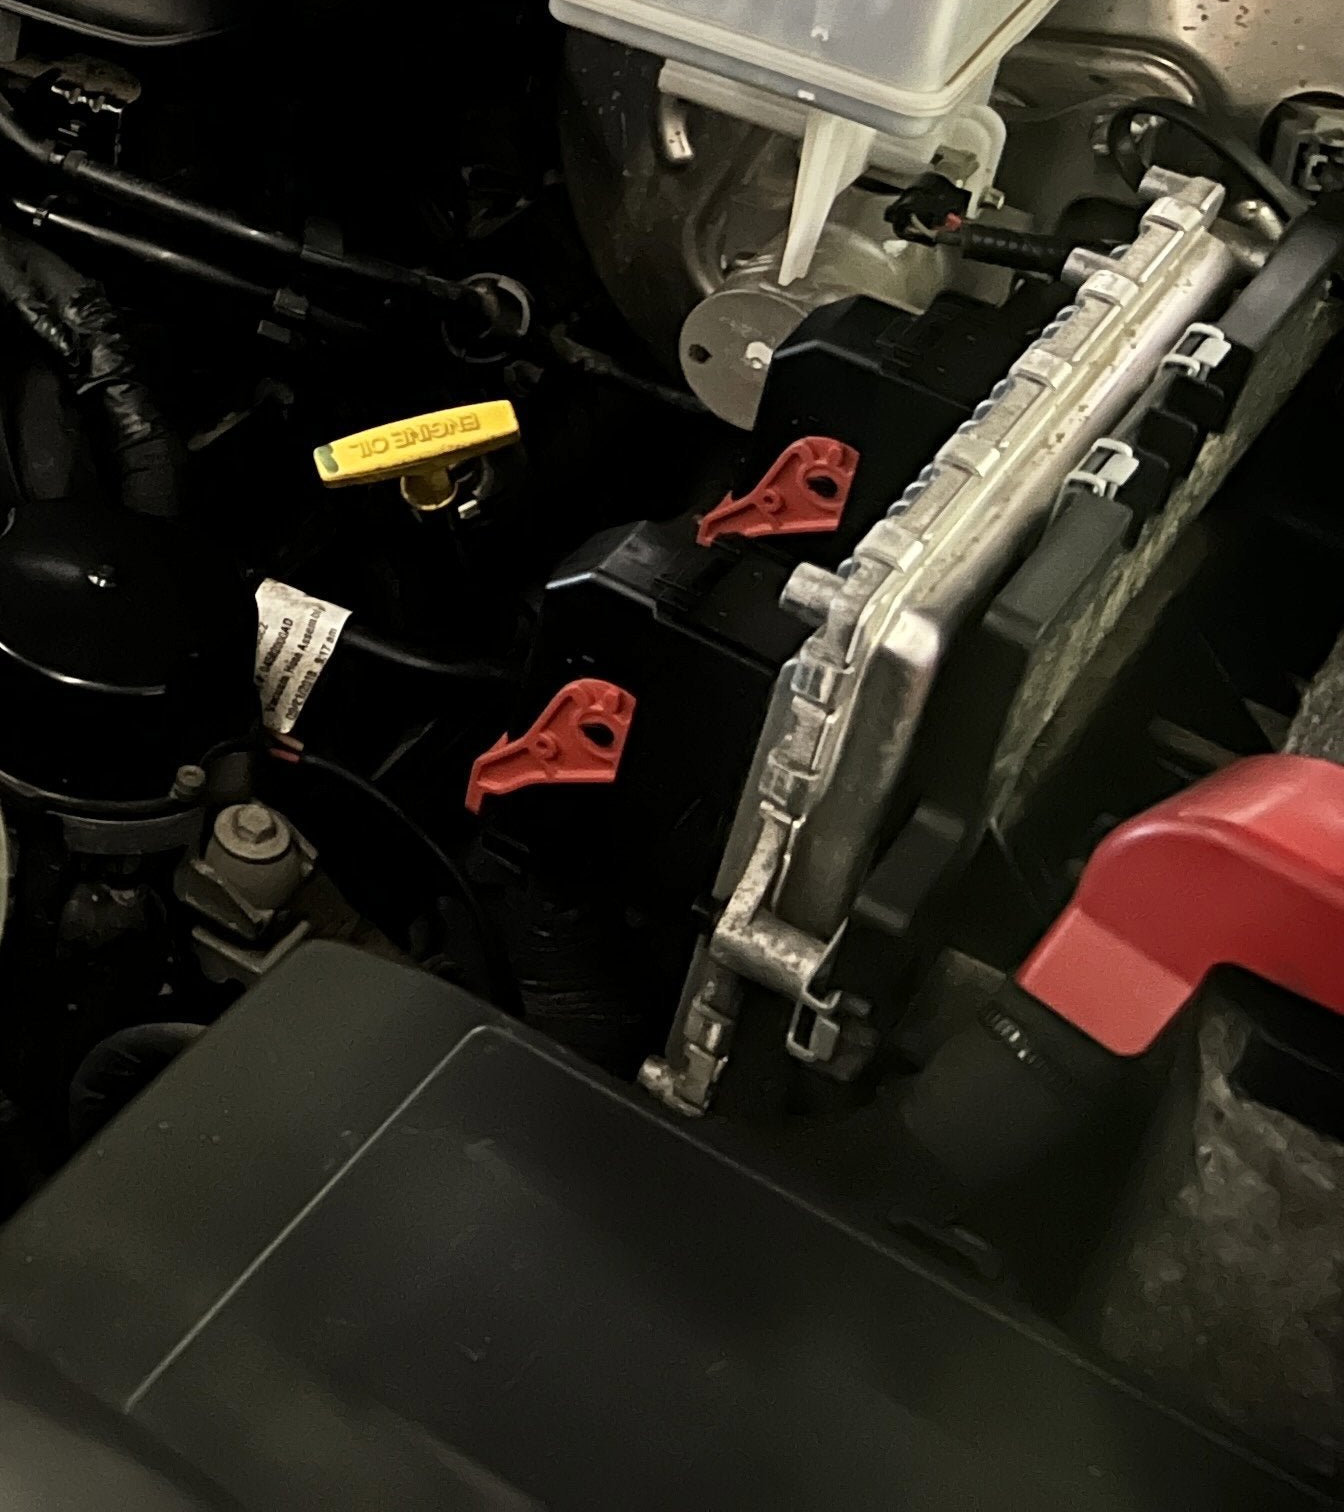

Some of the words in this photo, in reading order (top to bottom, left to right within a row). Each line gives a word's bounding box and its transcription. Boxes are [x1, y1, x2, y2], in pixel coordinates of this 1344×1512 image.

[349, 437, 389, 458] OIL
[391, 413, 481, 450] ENGINE
[297, 605, 327, 651] Assembly
